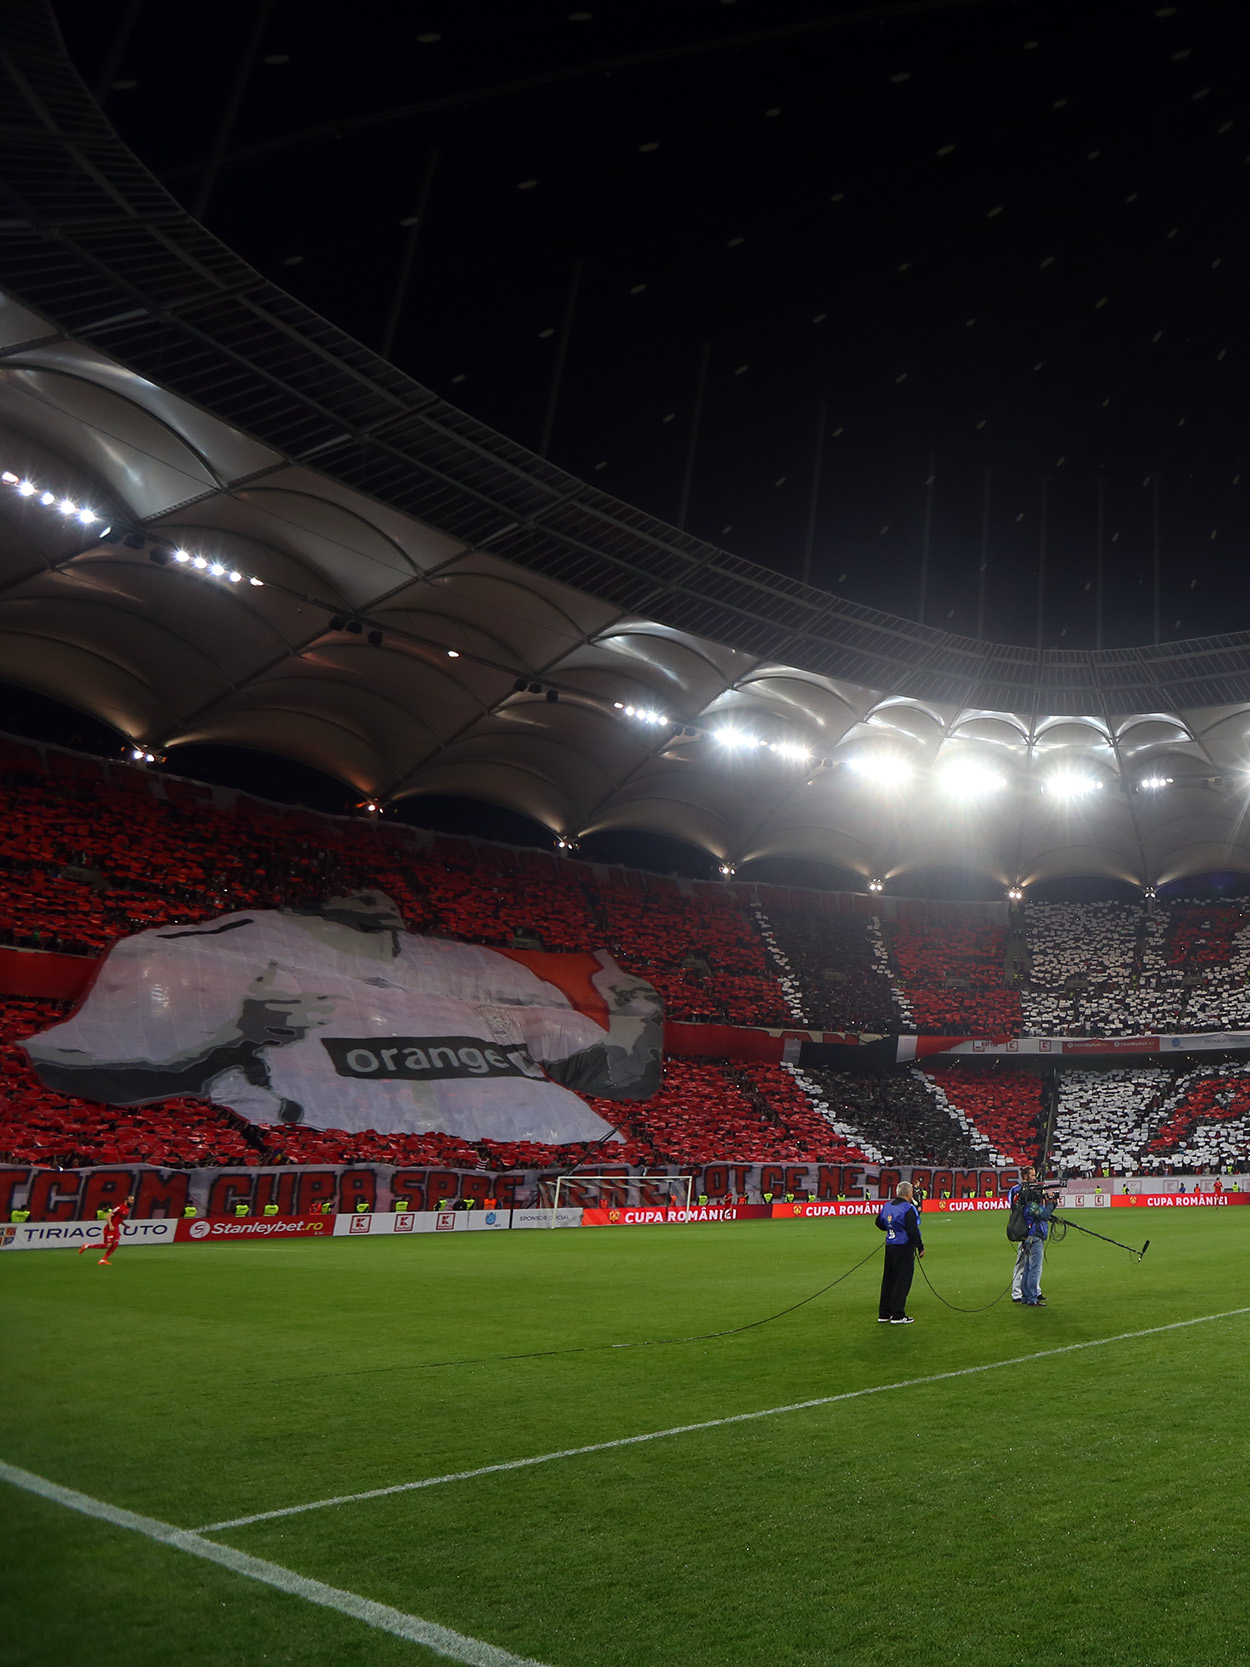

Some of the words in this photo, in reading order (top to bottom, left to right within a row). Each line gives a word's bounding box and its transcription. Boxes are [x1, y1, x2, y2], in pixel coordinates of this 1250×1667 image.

[346, 1046, 510, 1074] orange
[208, 1168, 378, 1218] CUPA
[389, 1170, 526, 1212] SPRE
[760, 1165, 809, 1199] CE
[949, 1202, 975, 1212] CUPA
[977, 1198, 1012, 1210] ROMÂN
[1147, 1197, 1174, 1207] CUPA
[805, 1204, 837, 1217] CUPA
[625, 1211, 664, 1224] CUPA
[123, 1225, 168, 1236] UTO
[211, 1221, 324, 1235] Stanleybet.ro
